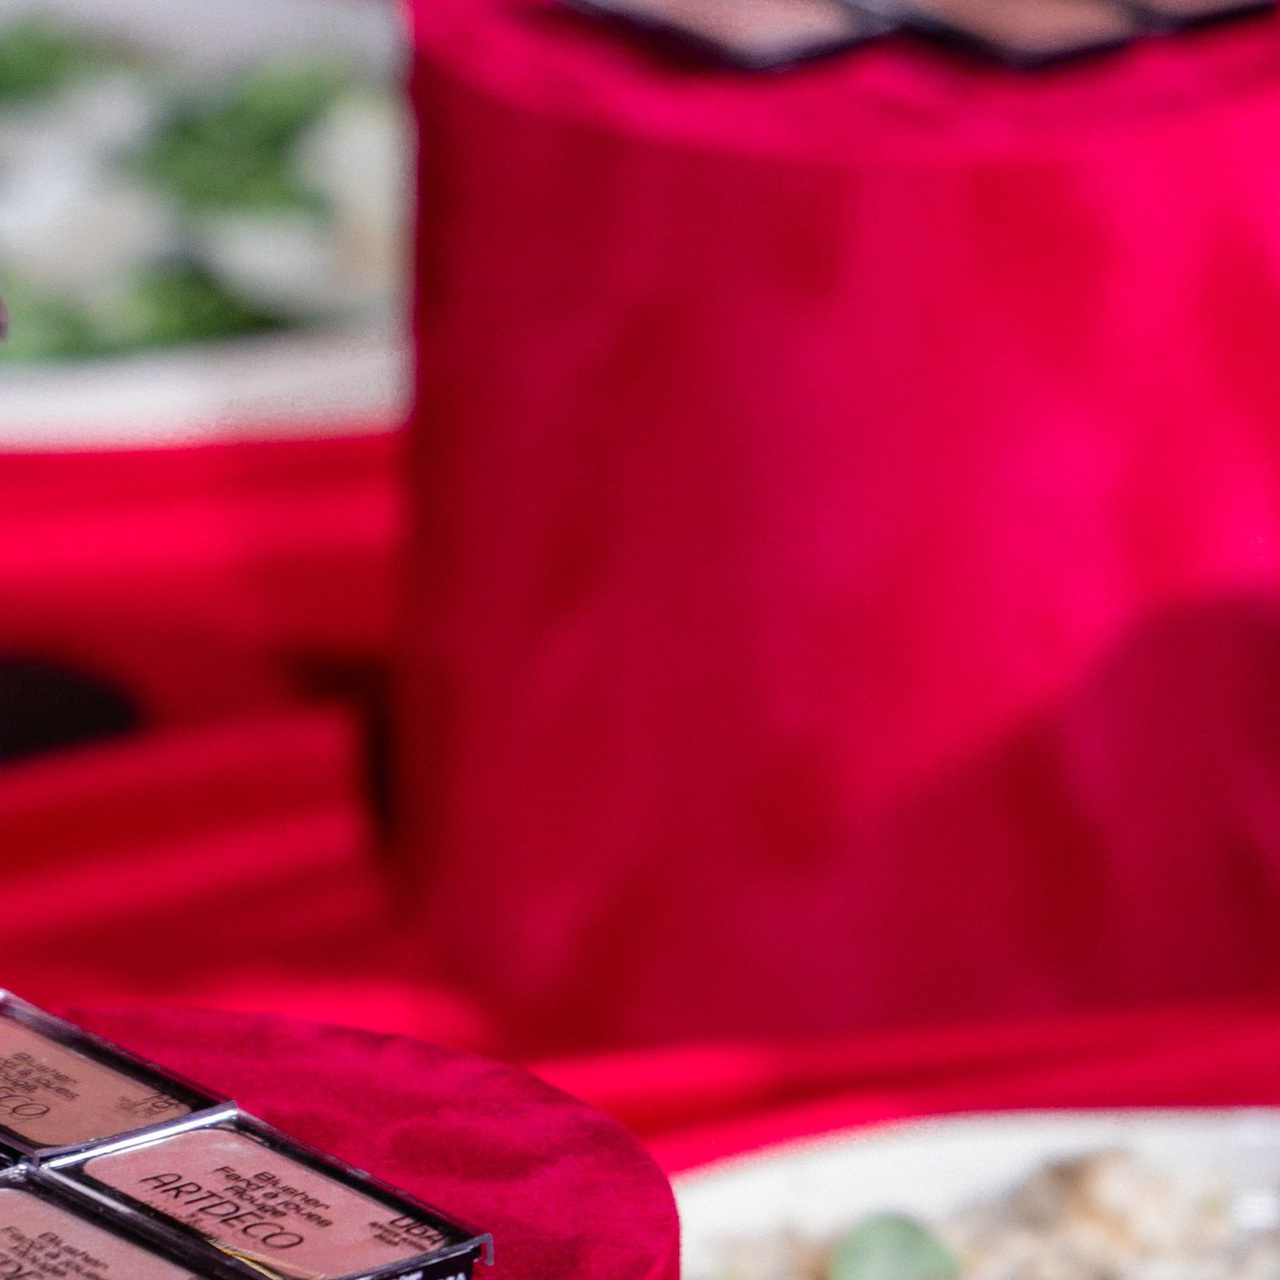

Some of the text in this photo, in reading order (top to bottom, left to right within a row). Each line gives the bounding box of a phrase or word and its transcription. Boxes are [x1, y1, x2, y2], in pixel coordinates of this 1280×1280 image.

[213, 1166, 265, 1191] Fard
[253, 1171, 330, 1210] Blusher
[138, 1173, 304, 1249] ARTDECO
[224, 1185, 287, 1218] Rouge
